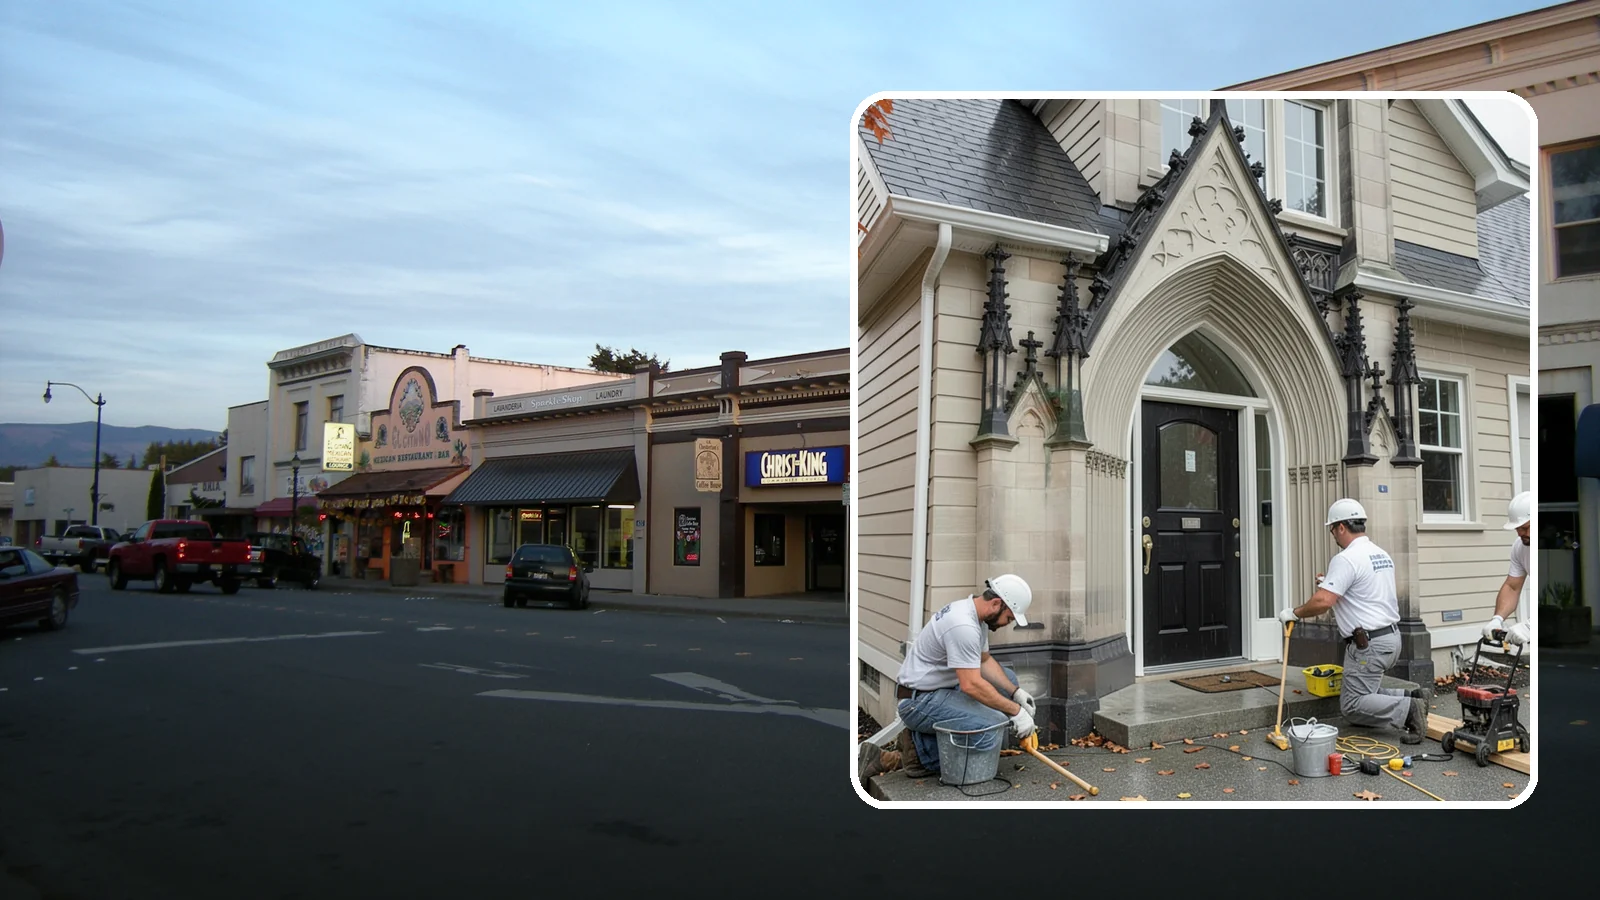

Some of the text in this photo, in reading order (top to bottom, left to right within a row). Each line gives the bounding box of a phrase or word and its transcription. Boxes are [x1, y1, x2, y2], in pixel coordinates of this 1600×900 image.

[562, 393, 582, 405] Shop
[595, 389, 623, 399] LAUNDRY
[494, 402, 522, 412] LAVANDERIA
[398, 451, 433, 461] RESTAURANT
[438, 450, 450, 459] BAR
[761, 449, 827, 478] CHRIST KING
